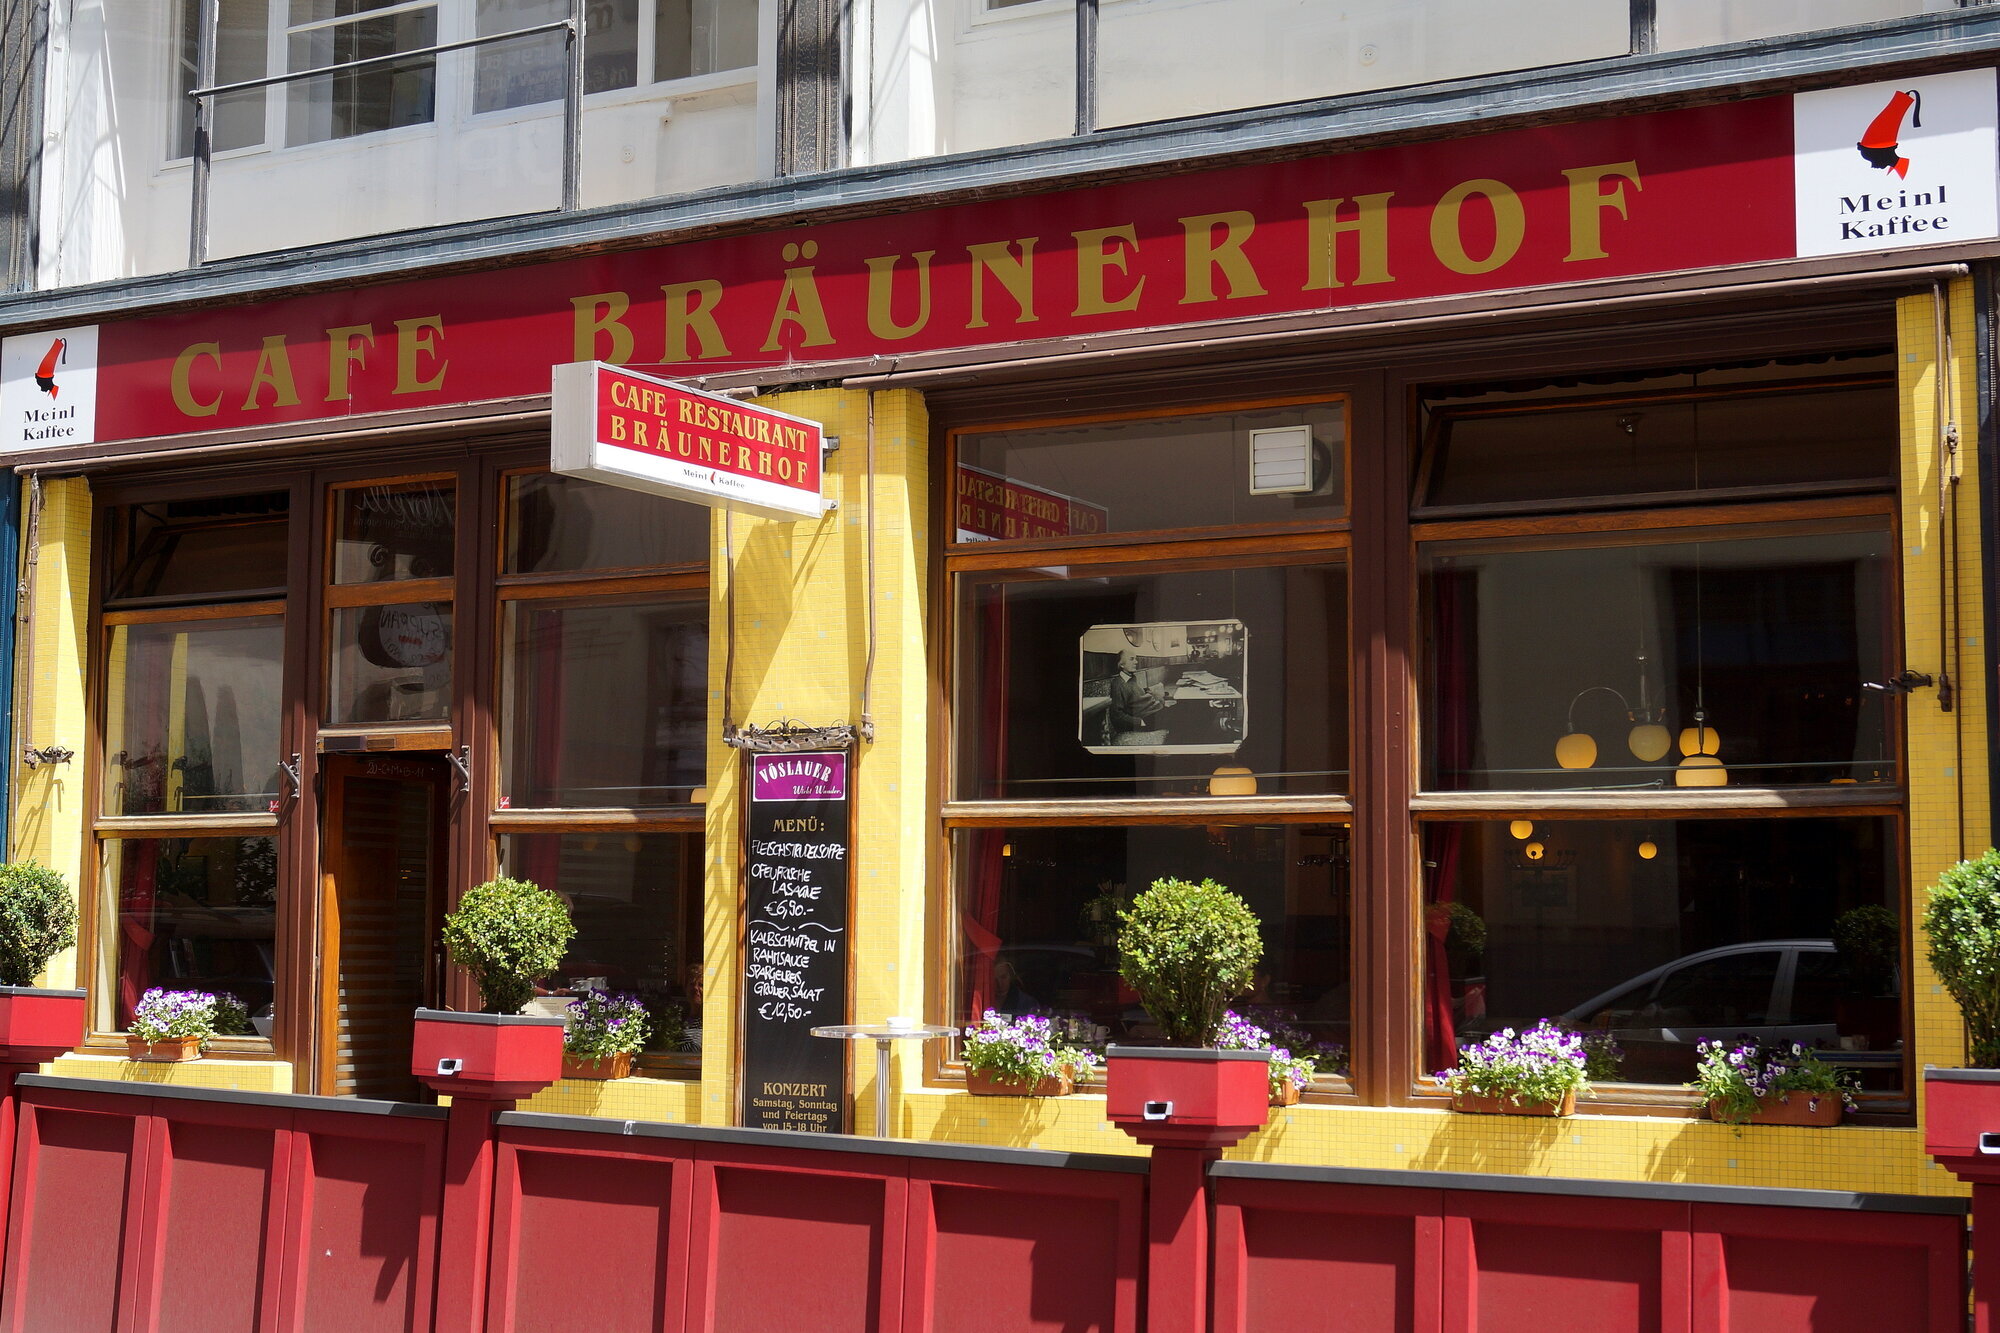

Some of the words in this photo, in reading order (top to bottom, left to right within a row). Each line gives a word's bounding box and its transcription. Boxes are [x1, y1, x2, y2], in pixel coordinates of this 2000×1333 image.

[1838, 185, 1948, 216] Meinl
[1839, 214, 1950, 241] Kaffee
[170, 312, 449, 418] CAFE
[570, 159, 1644, 365] BRÄUNERHOF
[24, 405, 75, 423] Meinl
[611, 381, 666, 417] CAFE
[679, 398, 808, 453] RESTAURANT
[23, 424, 75, 441] Kaffee
[610, 414, 808, 484] BRÄUNERHOF
[683, 468, 707, 480] Meinl
[719, 477, 745, 489] Kaffee
[759, 760, 832, 784] VÖSLAUER
[773, 815, 825, 832] MENÜ:
[772, 880, 822, 900] LASAGNE
[823, 939, 836, 952] IN
[753, 947, 810, 968] RAHMSAUCE
[791, 985, 825, 1002] SALAT
[763, 1082, 827, 1097] KONZERT
[752, 1097, 795, 1110] Samstag,
[798, 1099, 838, 1113] Sonntag
[762, 1110, 780, 1119] und
[785, 1111, 828, 1124] Feiertags
[762, 1122, 779, 1131] von
[783, 1122, 807, 1132] 15-18
[810, 1123, 827, 1133] Uhr
